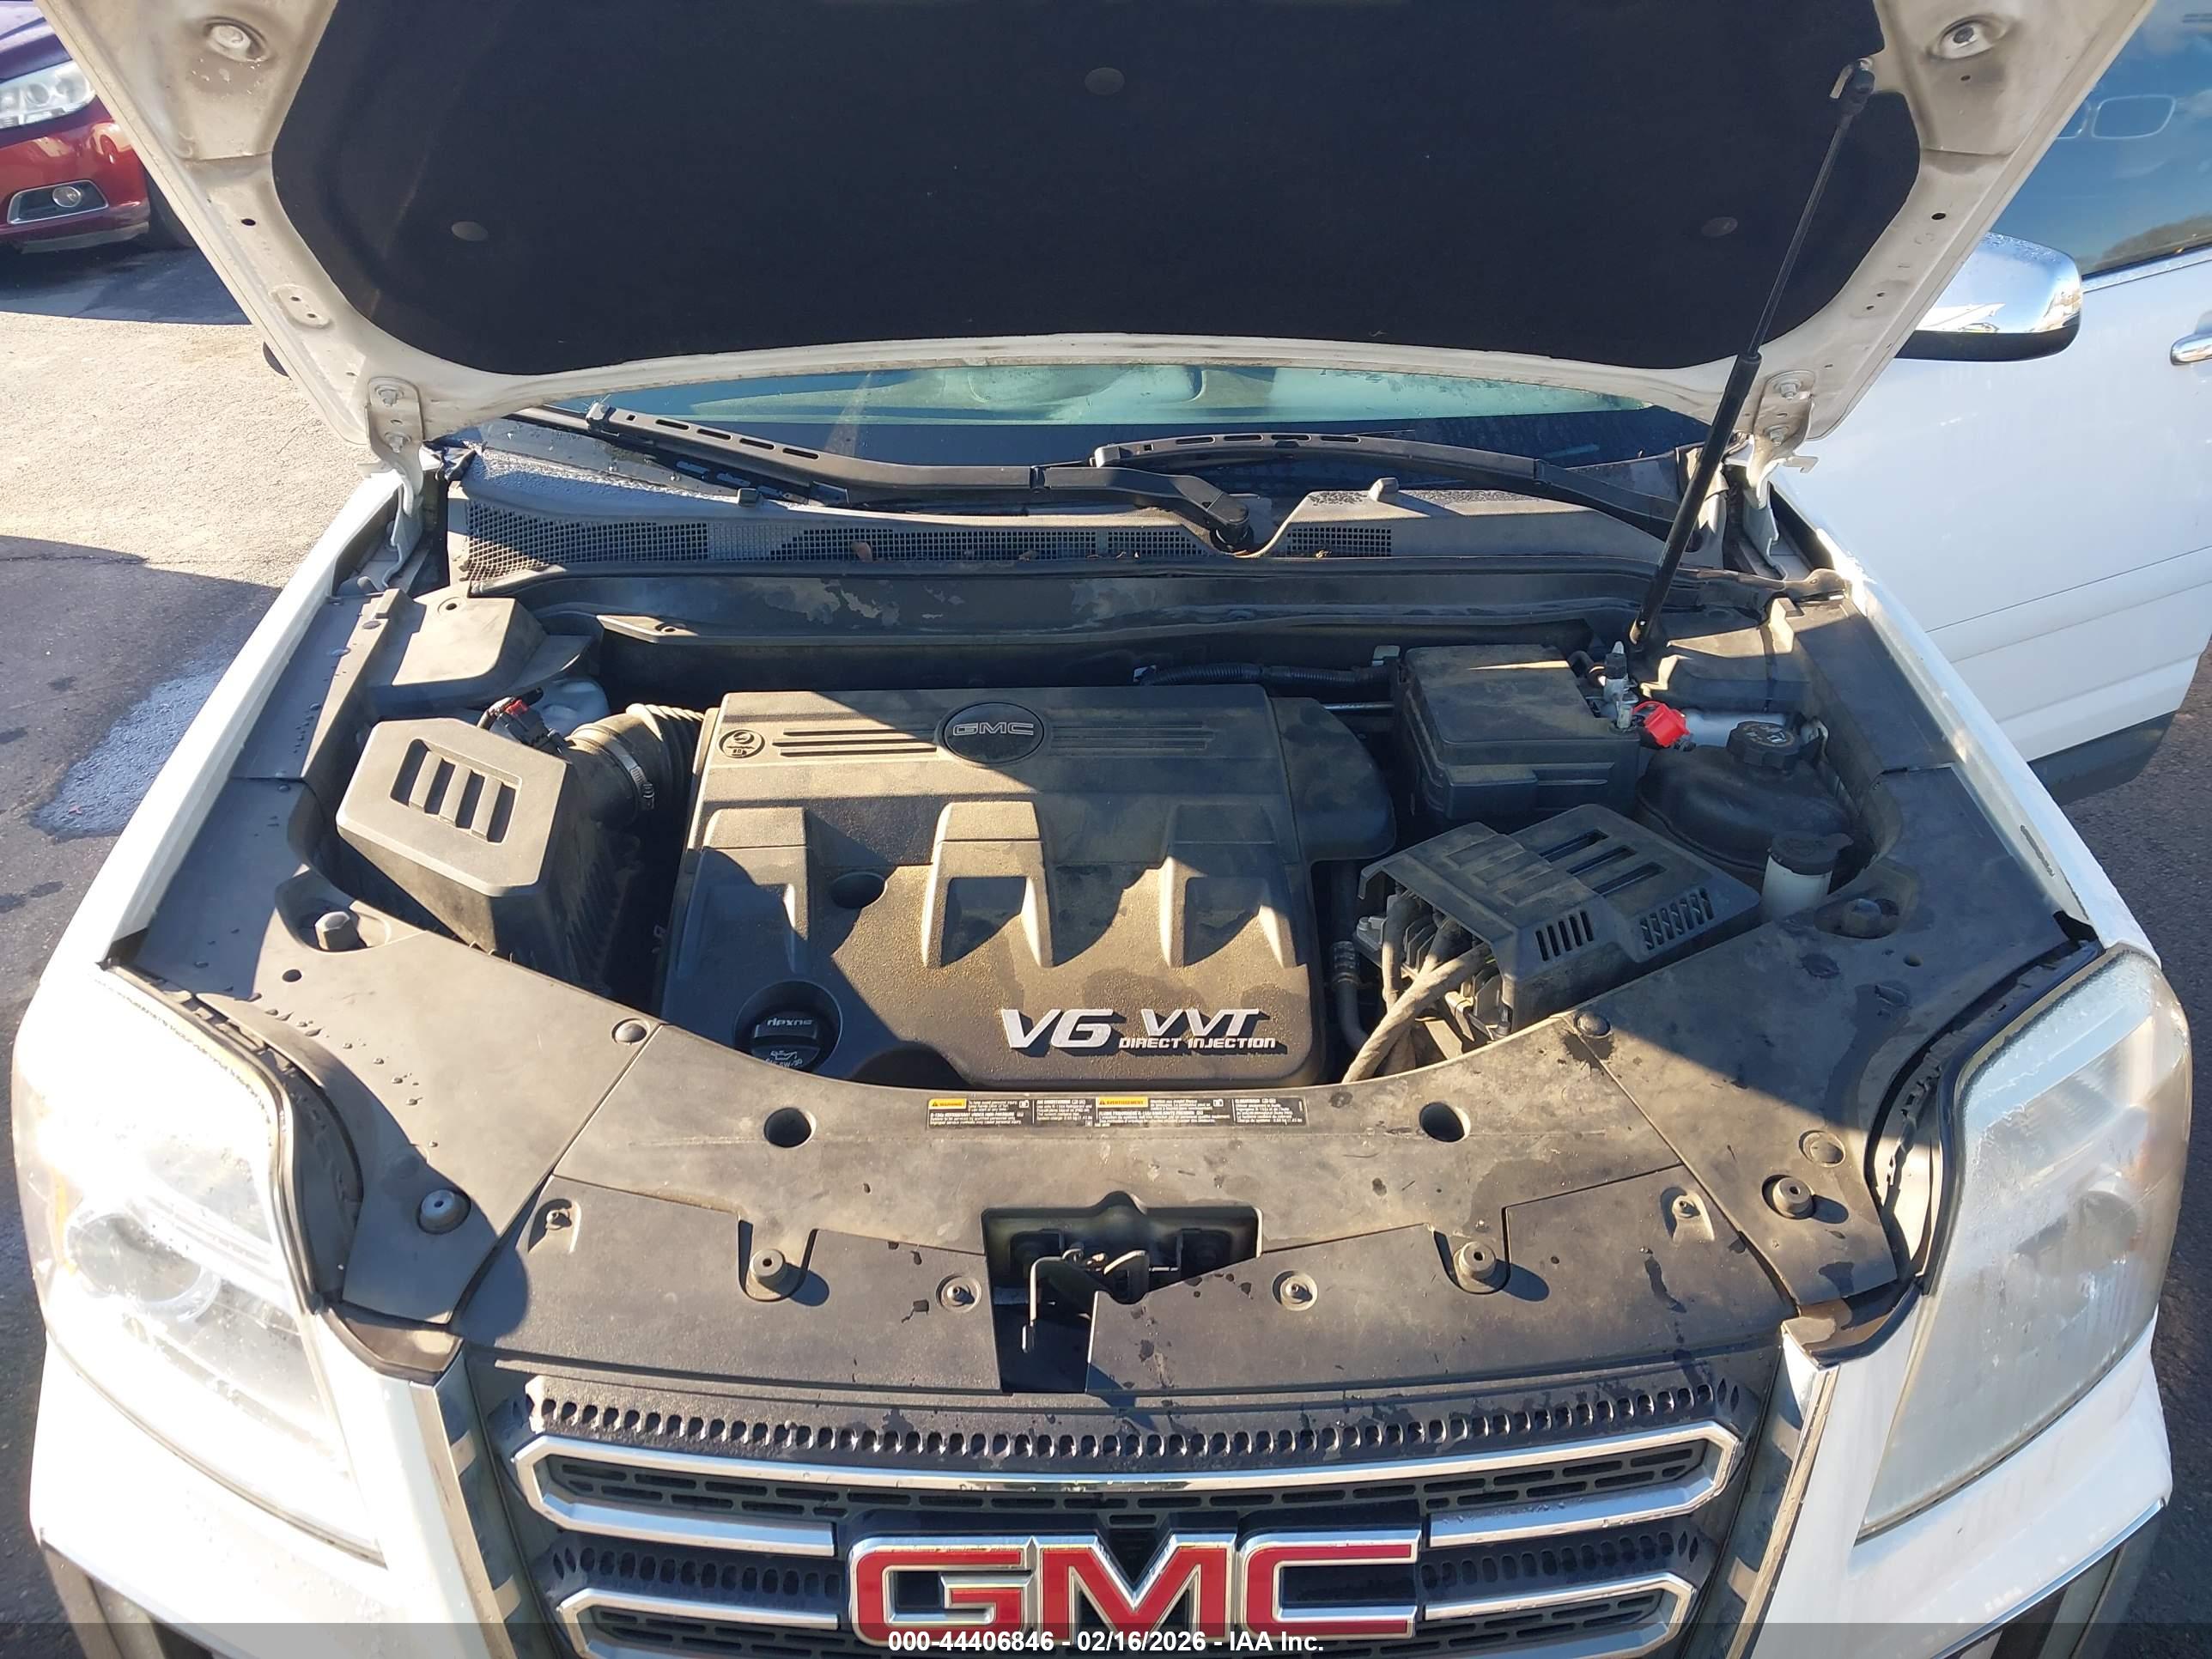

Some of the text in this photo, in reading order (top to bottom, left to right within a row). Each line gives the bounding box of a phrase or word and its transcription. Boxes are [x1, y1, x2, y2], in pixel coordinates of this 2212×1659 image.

[952, 721, 1035, 737] GMC
[1001, 1008, 1260, 1048] V6 VVT
[1118, 1037, 1276, 1049] DIRECT INJECTION
[850, 1532, 1421, 1647] GMC
